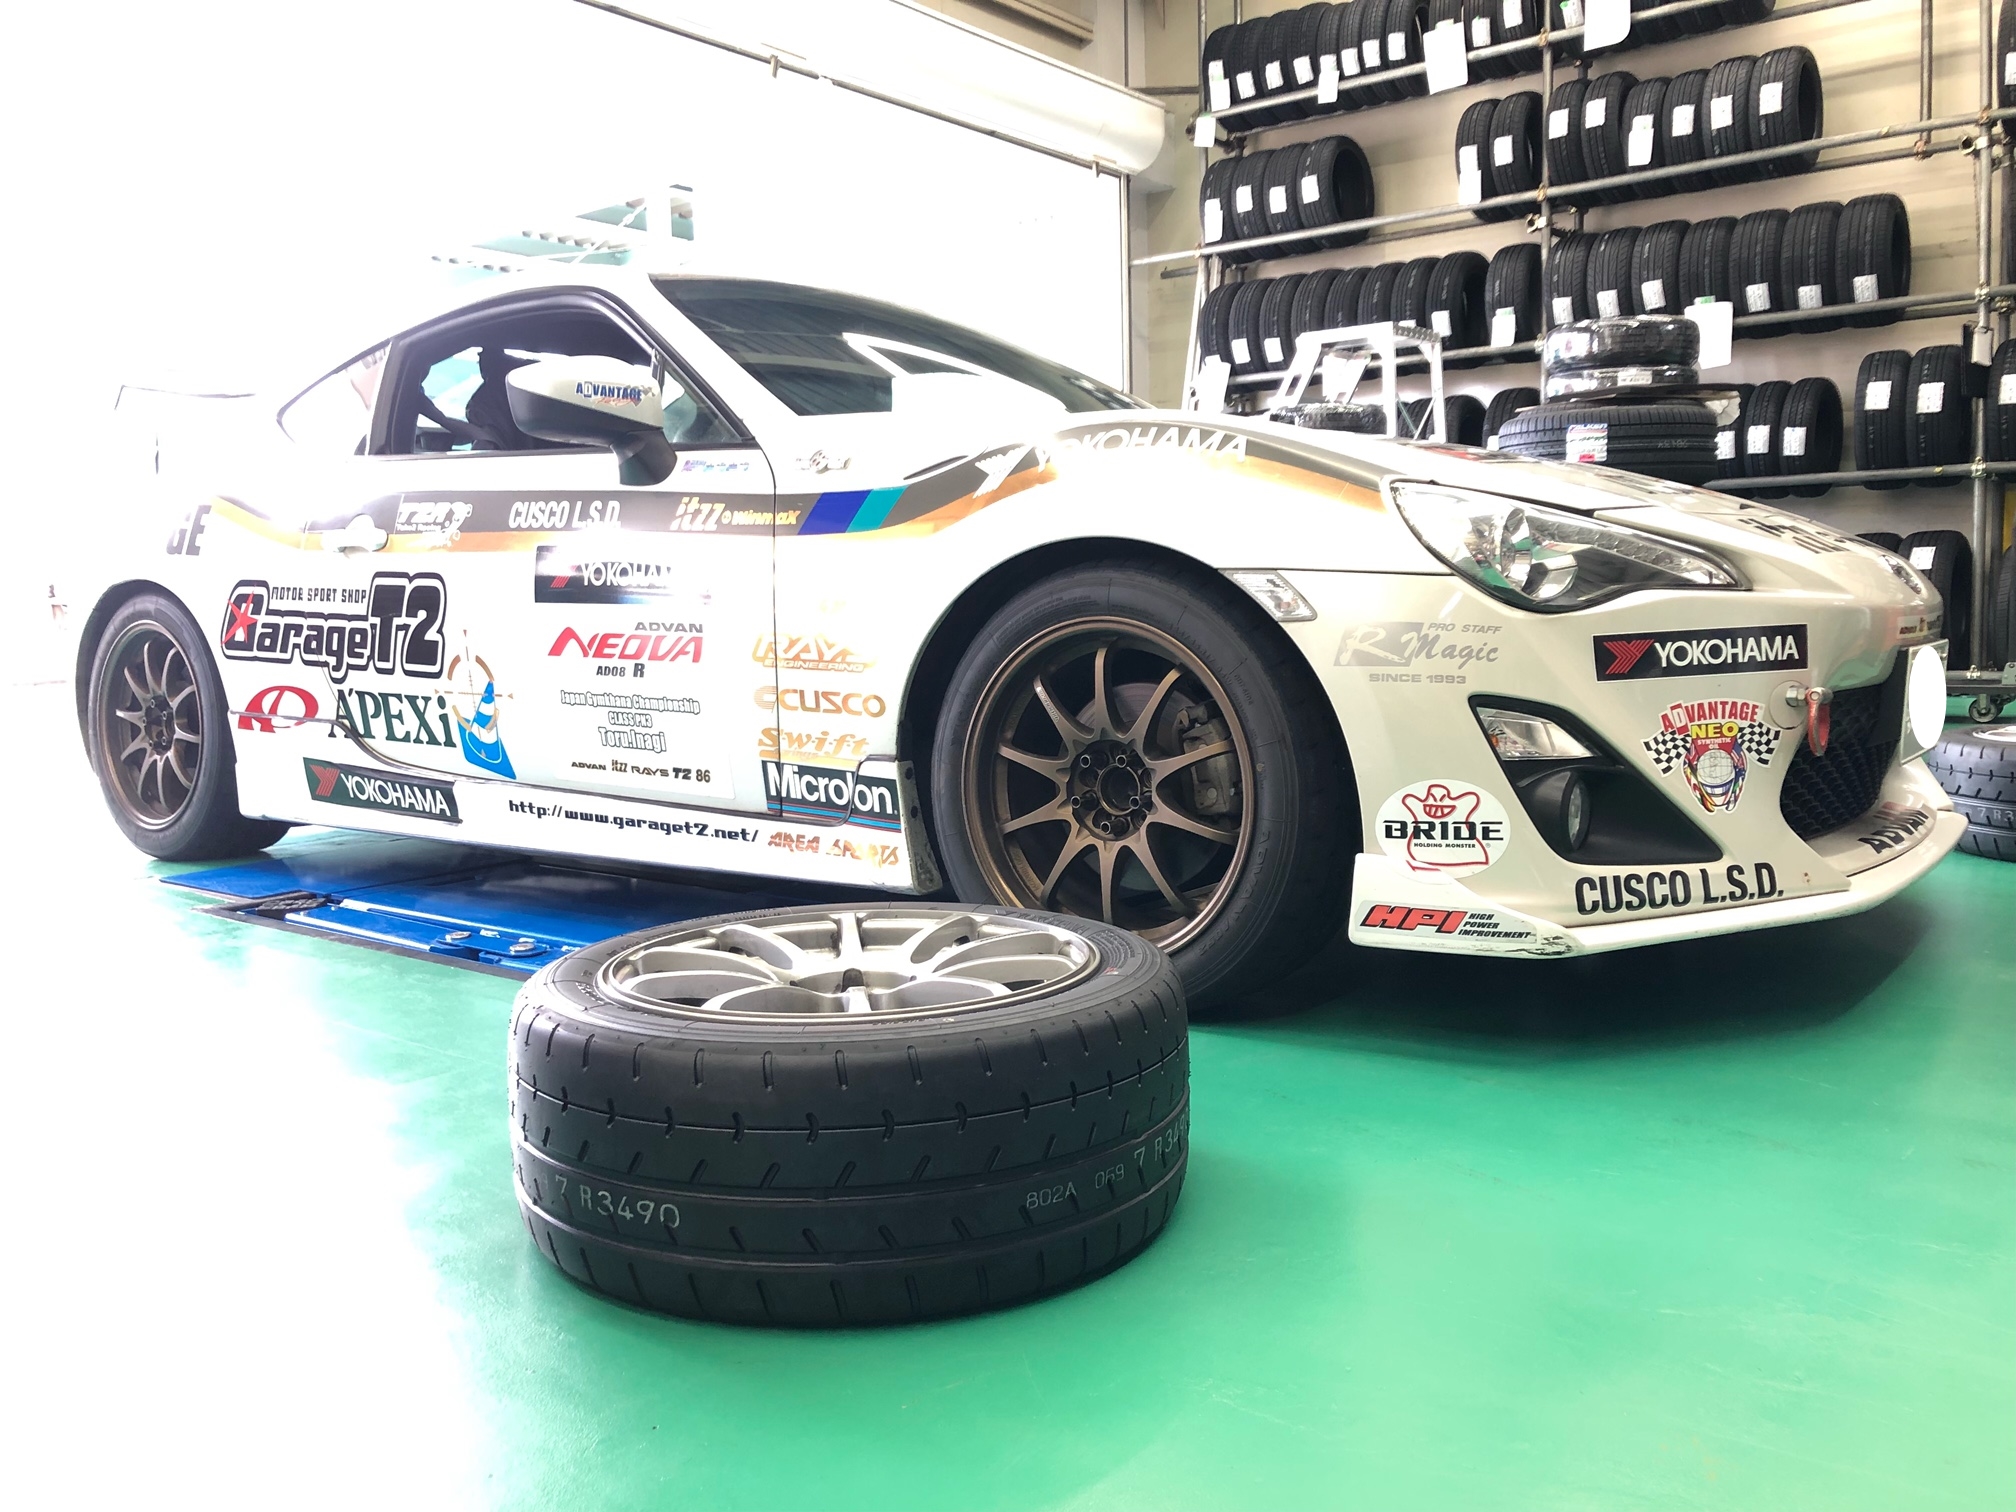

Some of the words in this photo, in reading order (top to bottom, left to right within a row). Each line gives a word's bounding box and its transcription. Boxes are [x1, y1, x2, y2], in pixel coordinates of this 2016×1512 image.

[508, 500, 569, 529] CUSCO
[572, 500, 622, 531] L.S.D.
[271, 587, 303, 601] MOTOR
[307, 587, 337, 602] SPORT
[342, 588, 367, 603] SHOP
[634, 622, 703, 633] ADVAN
[1427, 623, 1456, 632] PRO
[1461, 624, 1503, 634] STAFF
[547, 626, 703, 663] NEOVA
[1401, 631, 1499, 670] Magic
[1654, 635, 1800, 668] YOKOHAMA
[596, 665, 626, 677] AD08
[633, 662, 646, 678] R
[763, 658, 865, 673] ENGINEERING
[1369, 673, 1422, 683] SINCE
[1426, 674, 1467, 684] 1993
[560, 690, 586, 706] Japan
[586, 691, 633, 708] Gymkhana
[632, 694, 701, 715] Championship
[778, 688, 886, 718] CUSCO
[608, 711, 635, 726] CLASS
[1660, 700, 1759, 736] ADVANTAGE
[1690, 722, 1739, 739] NEO
[571, 761, 606, 771] ADVAN
[631, 765, 670, 777] RAYS
[672, 767, 692, 780] T2
[695, 769, 711, 783] 86
[340, 773, 452, 816] YOKOHAMA
[509, 800, 759, 843] http://www.garaget2.net/
[1382, 820, 1504, 841] BRIDE
[768, 831, 820, 853] AREA
[1575, 869, 1692, 916] CUSCO
[1699, 862, 1784, 904] L.S.D.
[1361, 904, 1468, 935] HPI
[1463, 921, 1501, 929] POWER
[1468, 913, 1495, 921] HIGH
[1458, 929, 1531, 939] IMPROVEMENT
[579, 1184, 680, 1228] R3490
